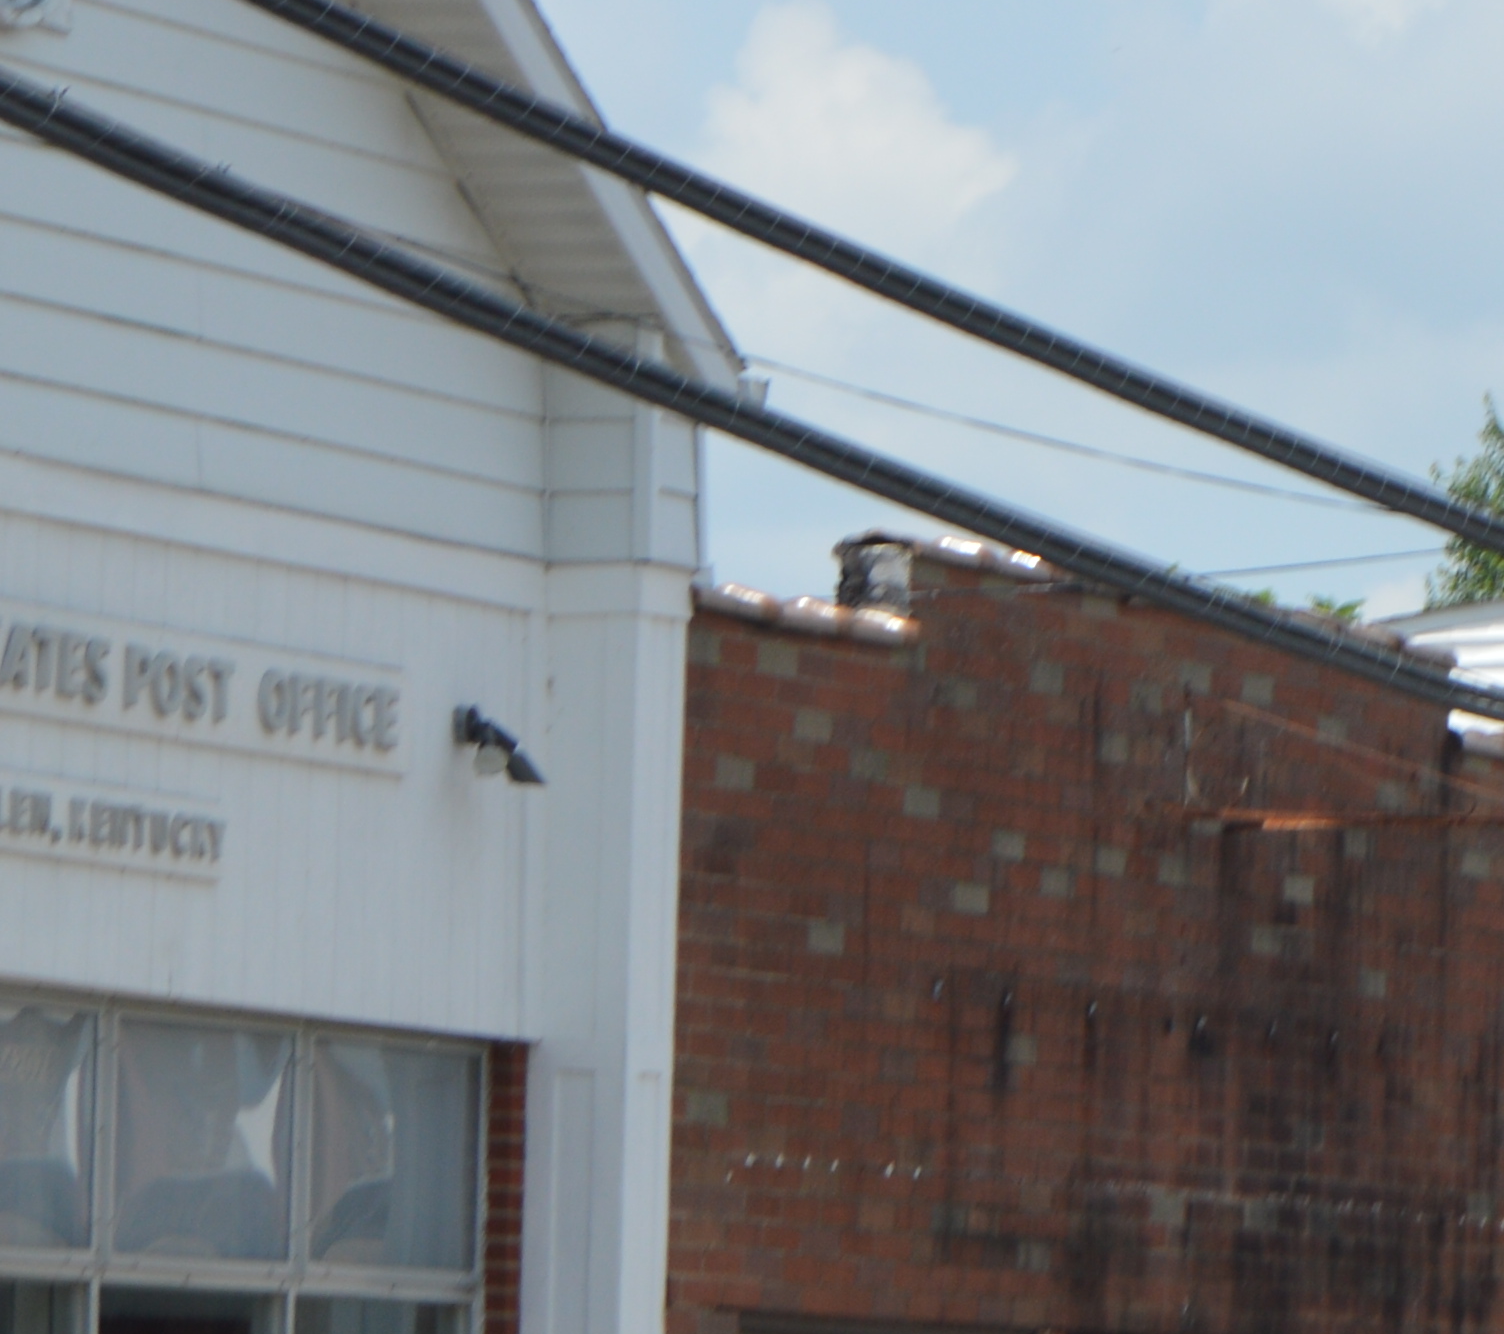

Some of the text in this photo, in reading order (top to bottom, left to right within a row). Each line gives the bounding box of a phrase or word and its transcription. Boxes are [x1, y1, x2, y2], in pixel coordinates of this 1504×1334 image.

[122, 642, 236, 726] POST
[256, 668, 402, 754] OFFICE
[68, 796, 228, 865] KENTUCKY
